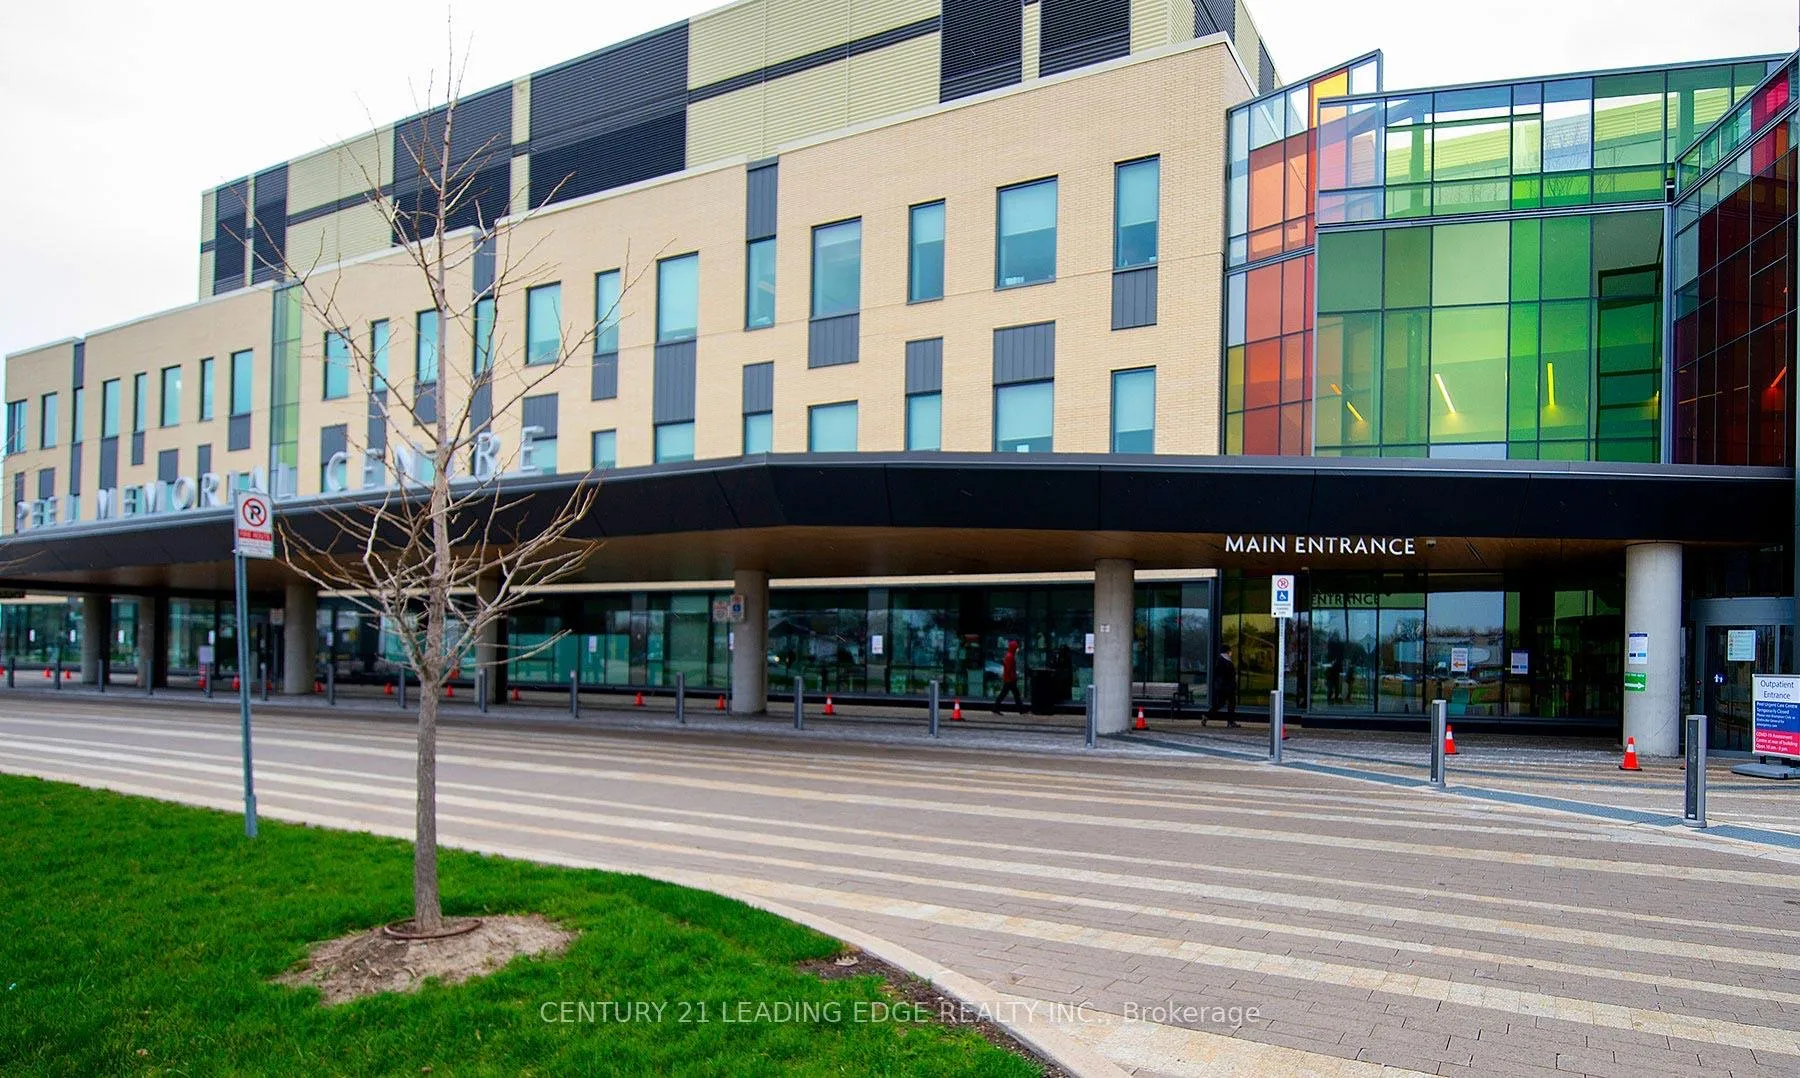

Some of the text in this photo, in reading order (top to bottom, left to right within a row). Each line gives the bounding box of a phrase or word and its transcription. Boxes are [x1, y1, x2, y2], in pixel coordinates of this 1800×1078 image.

[97, 462, 298, 521] MEMORIAL
[1225, 535, 1416, 555] MAIN ENTRANCE
[1760, 680, 1794, 689] Outpatient
[1763, 691, 1791, 699] Entrance
